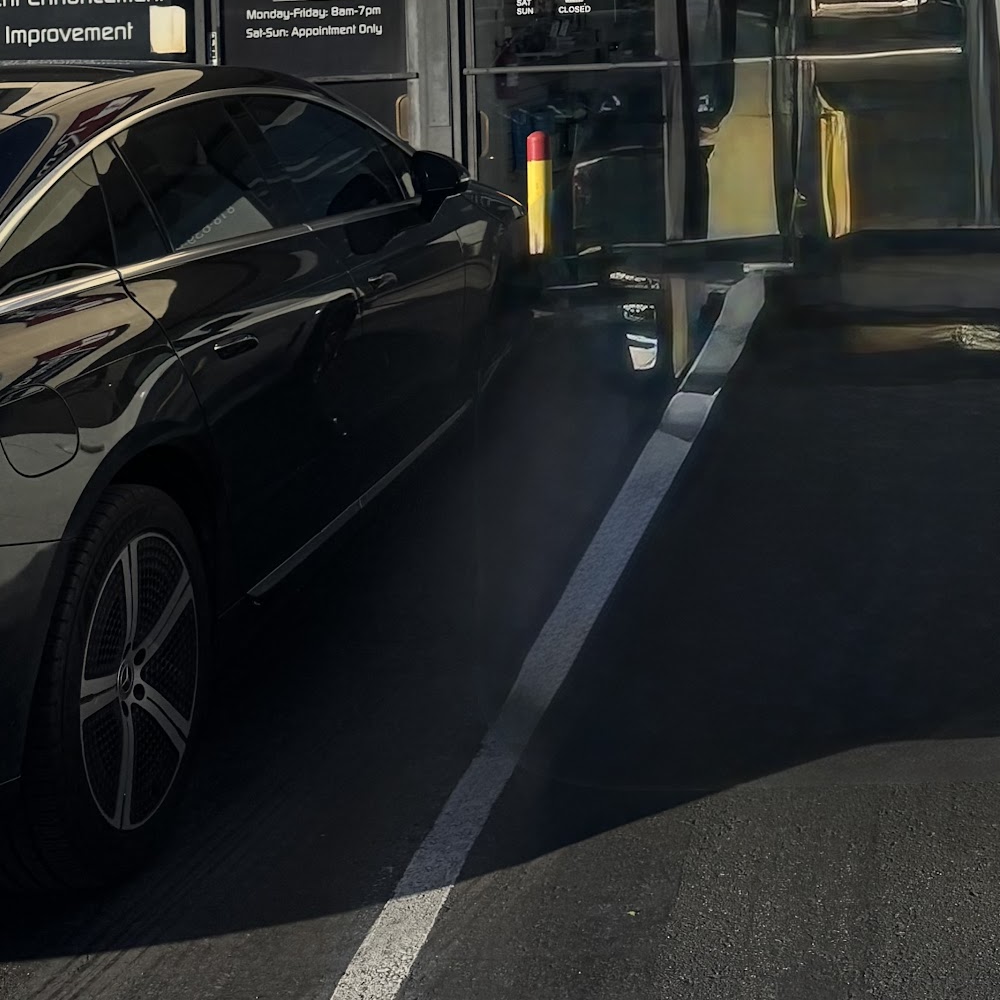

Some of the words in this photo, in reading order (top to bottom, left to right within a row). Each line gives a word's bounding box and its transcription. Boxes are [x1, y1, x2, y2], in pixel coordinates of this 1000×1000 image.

[516, 0, 532, 7] SAT
[516, 7, 534, 15] SUN
[558, 4, 591, 14] CLOSED
[246, 8, 329, 20] Monday-Friday:
[331, 6, 381, 18] 8am-7pm
[5, 22, 134, 47] Improvement
[246, 28, 289, 39] Sat-Sun:
[291, 25, 356, 38] Appointment
[358, 24, 383, 36] Only
